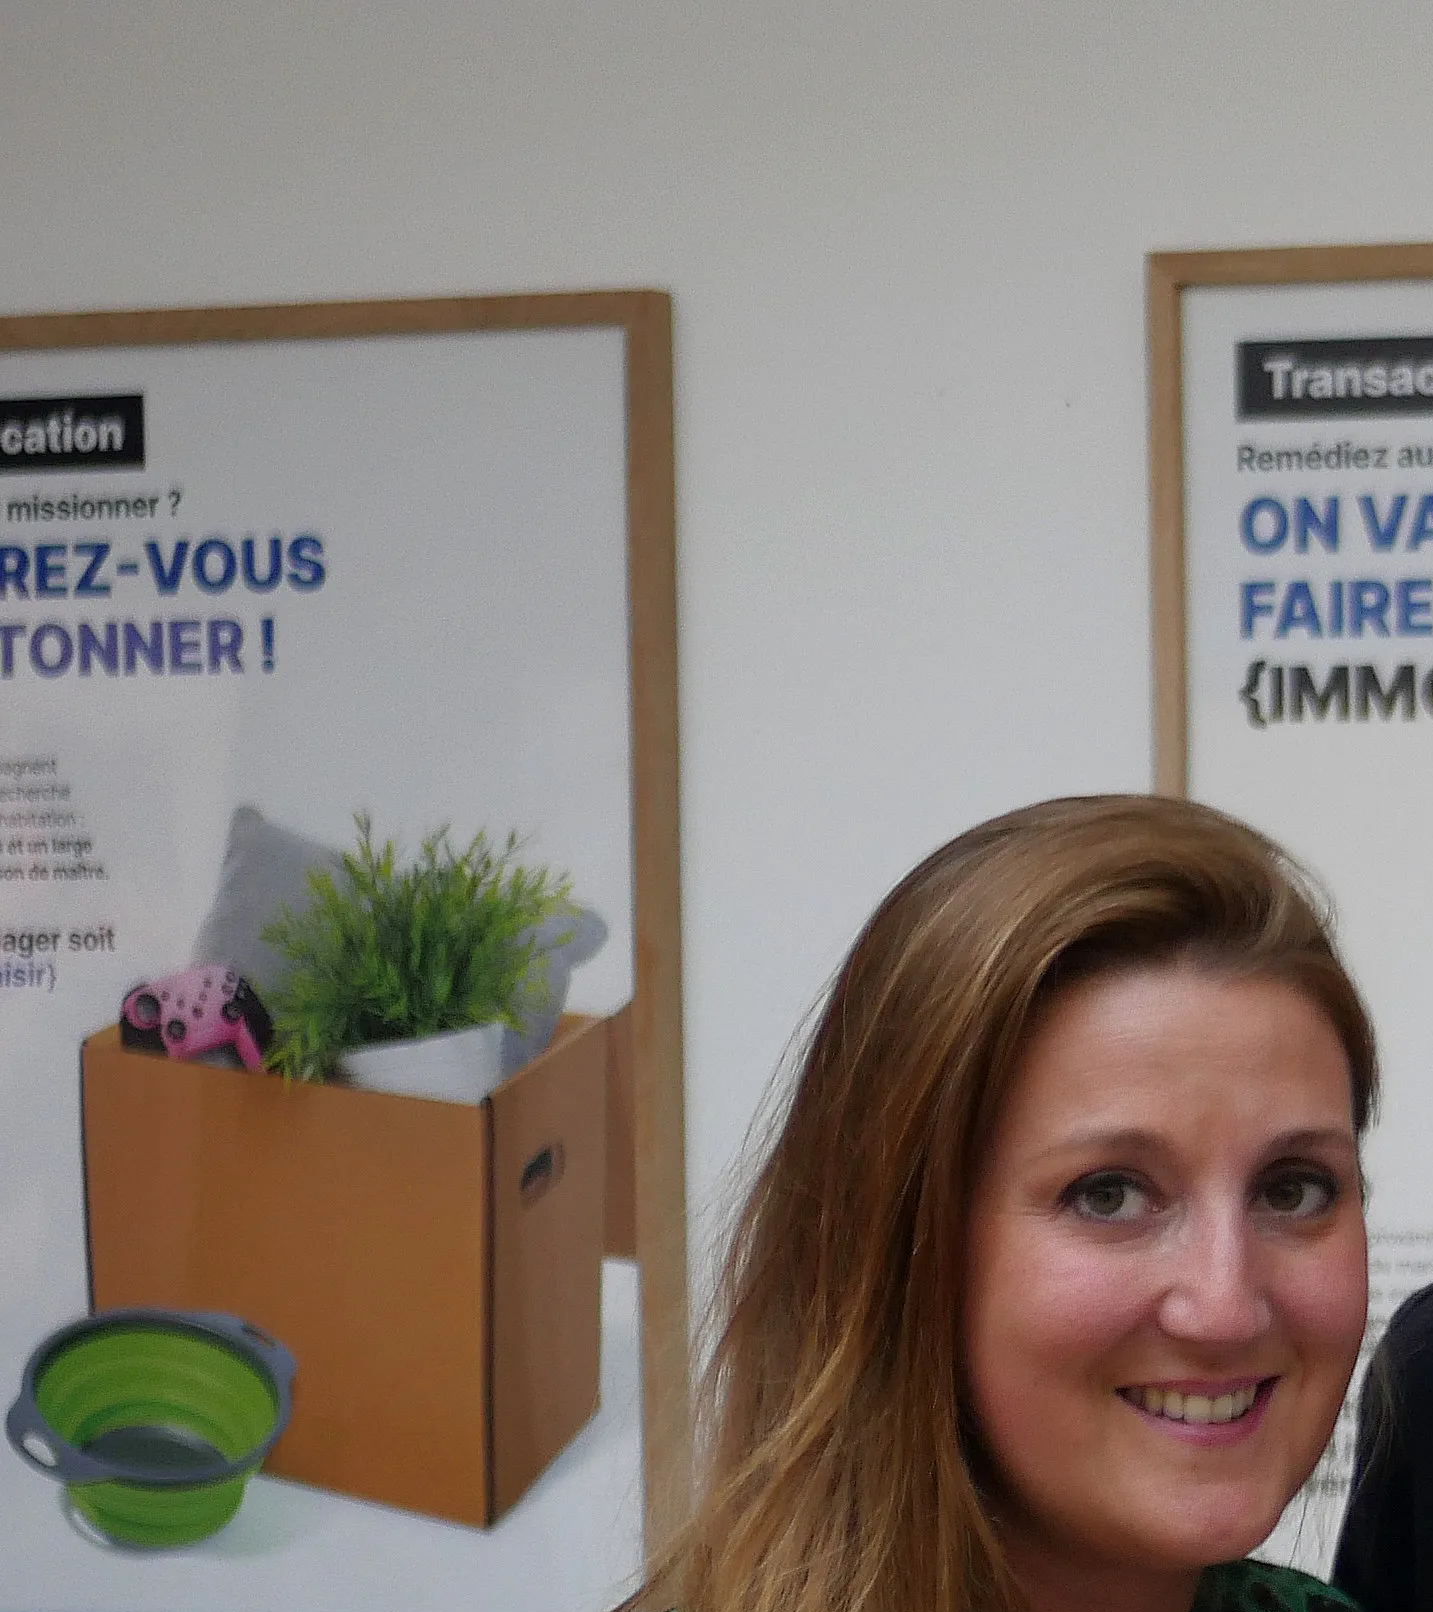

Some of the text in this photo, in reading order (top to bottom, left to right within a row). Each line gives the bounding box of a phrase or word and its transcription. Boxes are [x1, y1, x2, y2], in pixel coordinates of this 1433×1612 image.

[2, 412, 124, 455] cation
[1237, 440, 1390, 472] Remédiez
[7, 491, 182, 522] missionner ?
[1239, 494, 1341, 555] ON
[0, 537, 325, 598] REZ-VOUS
[1240, 578, 1433, 640] FAIRE
[0, 617, 276, 679] TONNER !
[69, 925, 116, 952] soit
